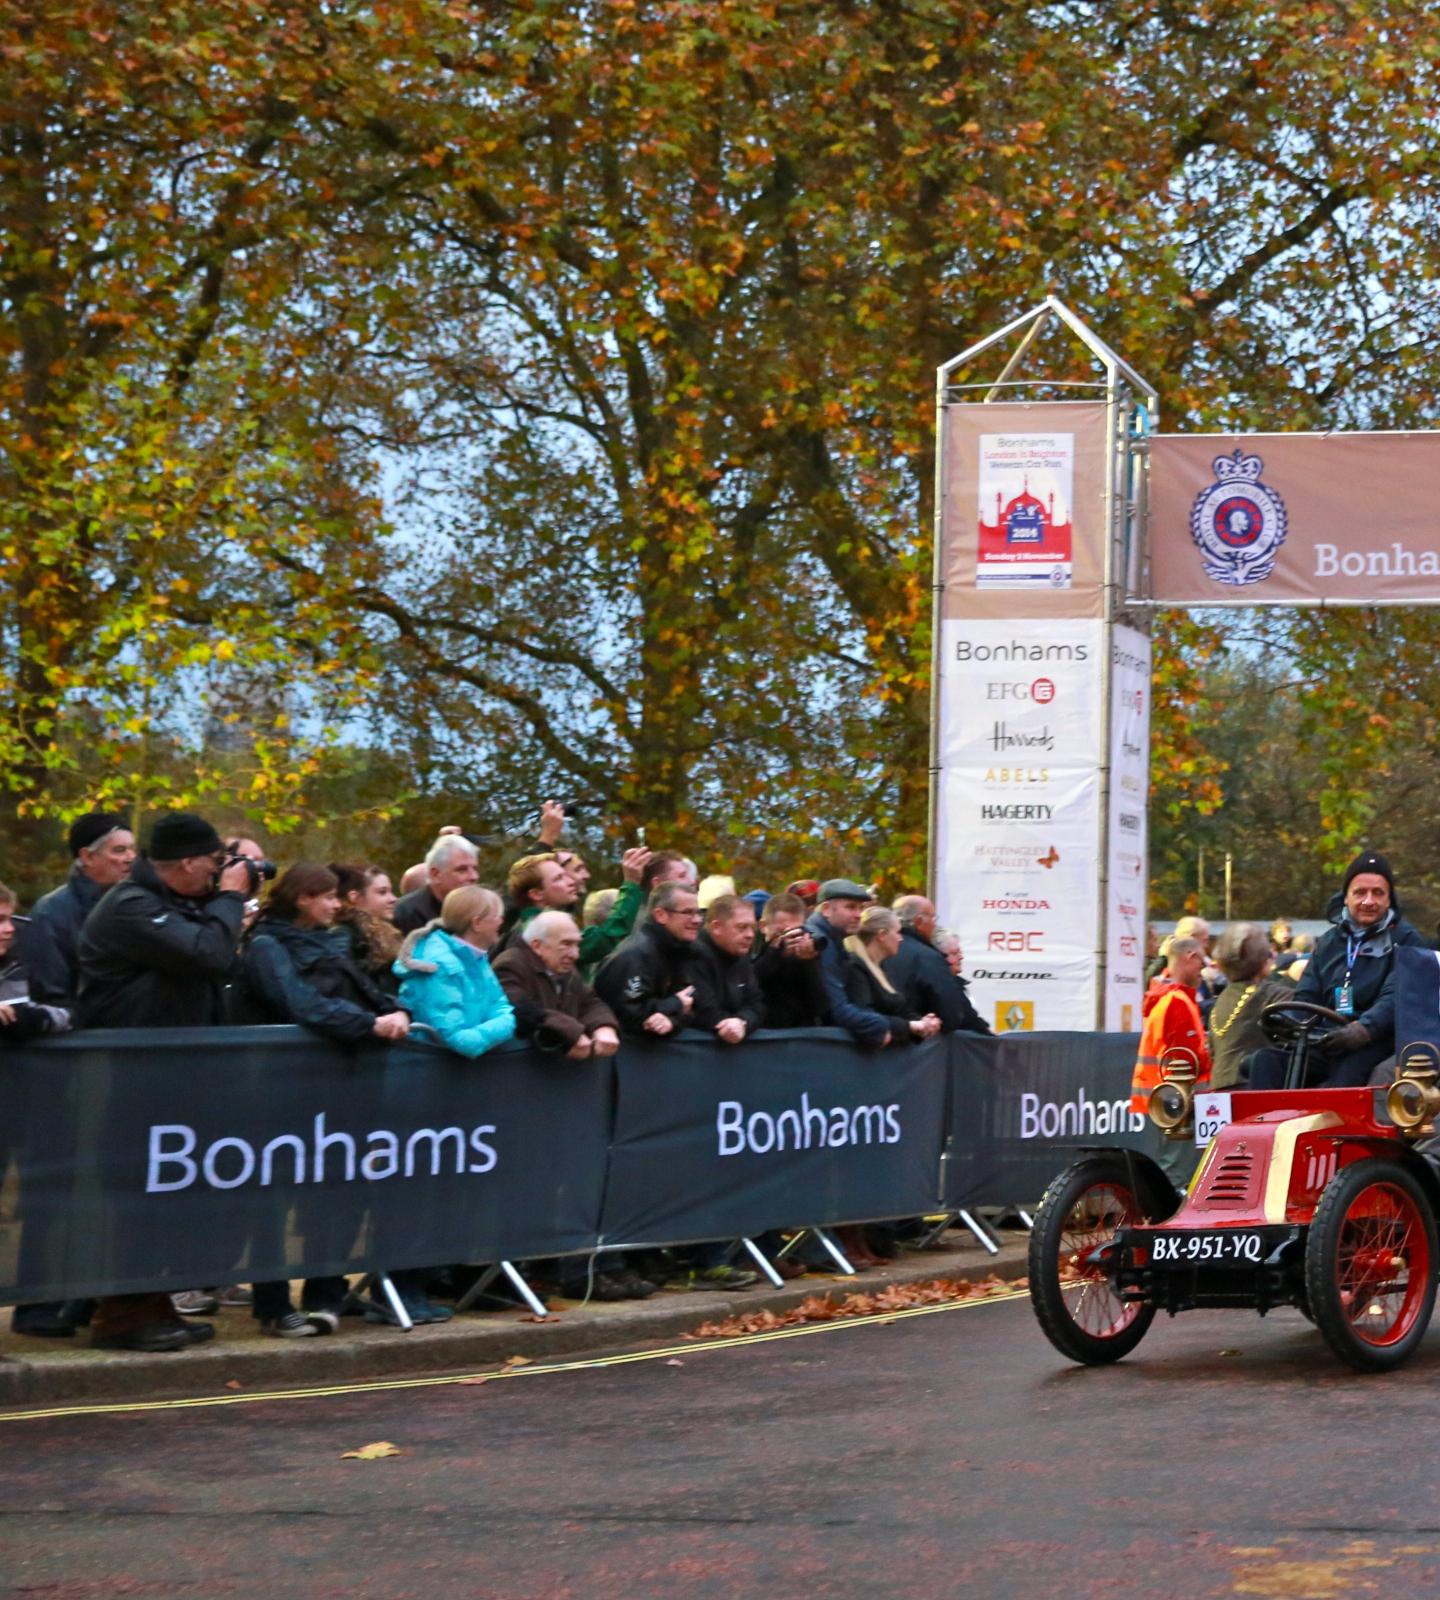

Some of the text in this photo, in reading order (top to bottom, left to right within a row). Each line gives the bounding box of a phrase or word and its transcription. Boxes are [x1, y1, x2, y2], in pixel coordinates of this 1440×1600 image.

[998, 438, 1055, 448] Bonhams
[1011, 527, 1038, 539] 2014
[956, 640, 1088, 662] Bonhams
[986, 682, 1028, 700] EFG
[987, 721, 1055, 751] Harrods
[984, 768, 1049, 782] ABELS
[981, 804, 1054, 819] HAGERTY
[983, 899, 1051, 909] HONDA
[972, 969, 1056, 980] Octane
[718, 1092, 901, 1157] Bonhams
[1199, 1121, 1228, 1138] 02
[145, 1111, 498, 1194] Bonhams
[1152, 1234, 1263, 1262] BX-951-YQ
